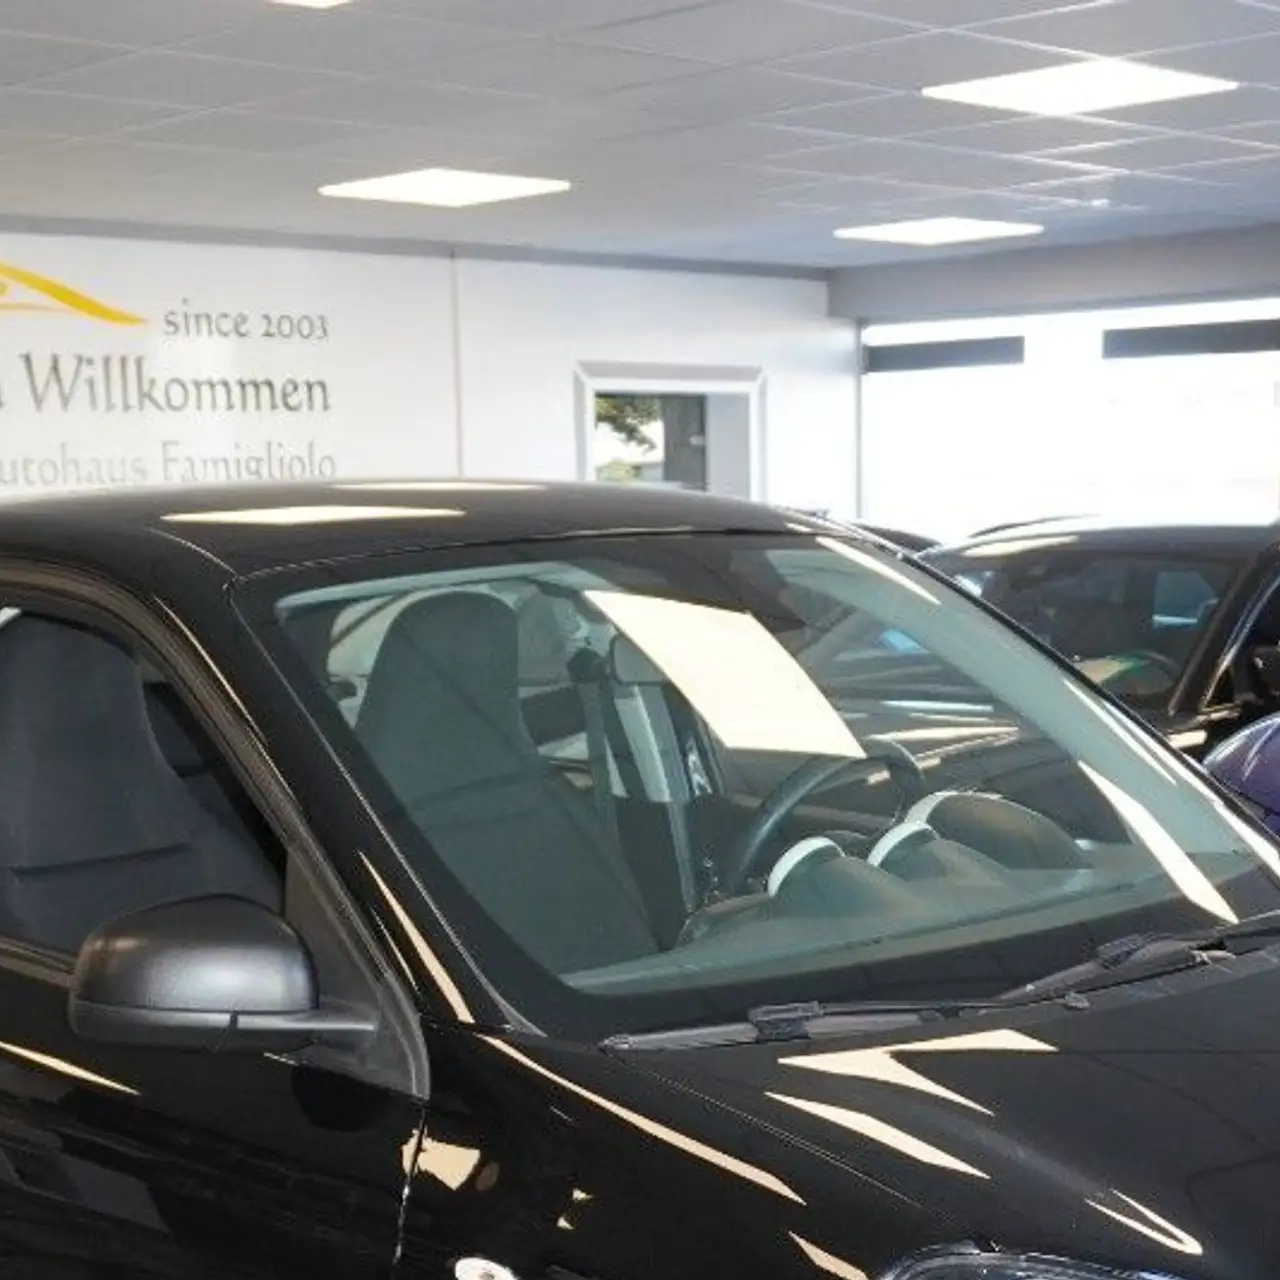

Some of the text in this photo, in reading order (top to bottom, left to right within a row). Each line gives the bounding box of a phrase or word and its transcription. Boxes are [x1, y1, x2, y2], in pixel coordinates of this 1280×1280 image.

[164, 298, 330, 340] since 2003
[19, 352, 331, 413] Willkommen
[151, 439, 336, 483] Famigliolo
